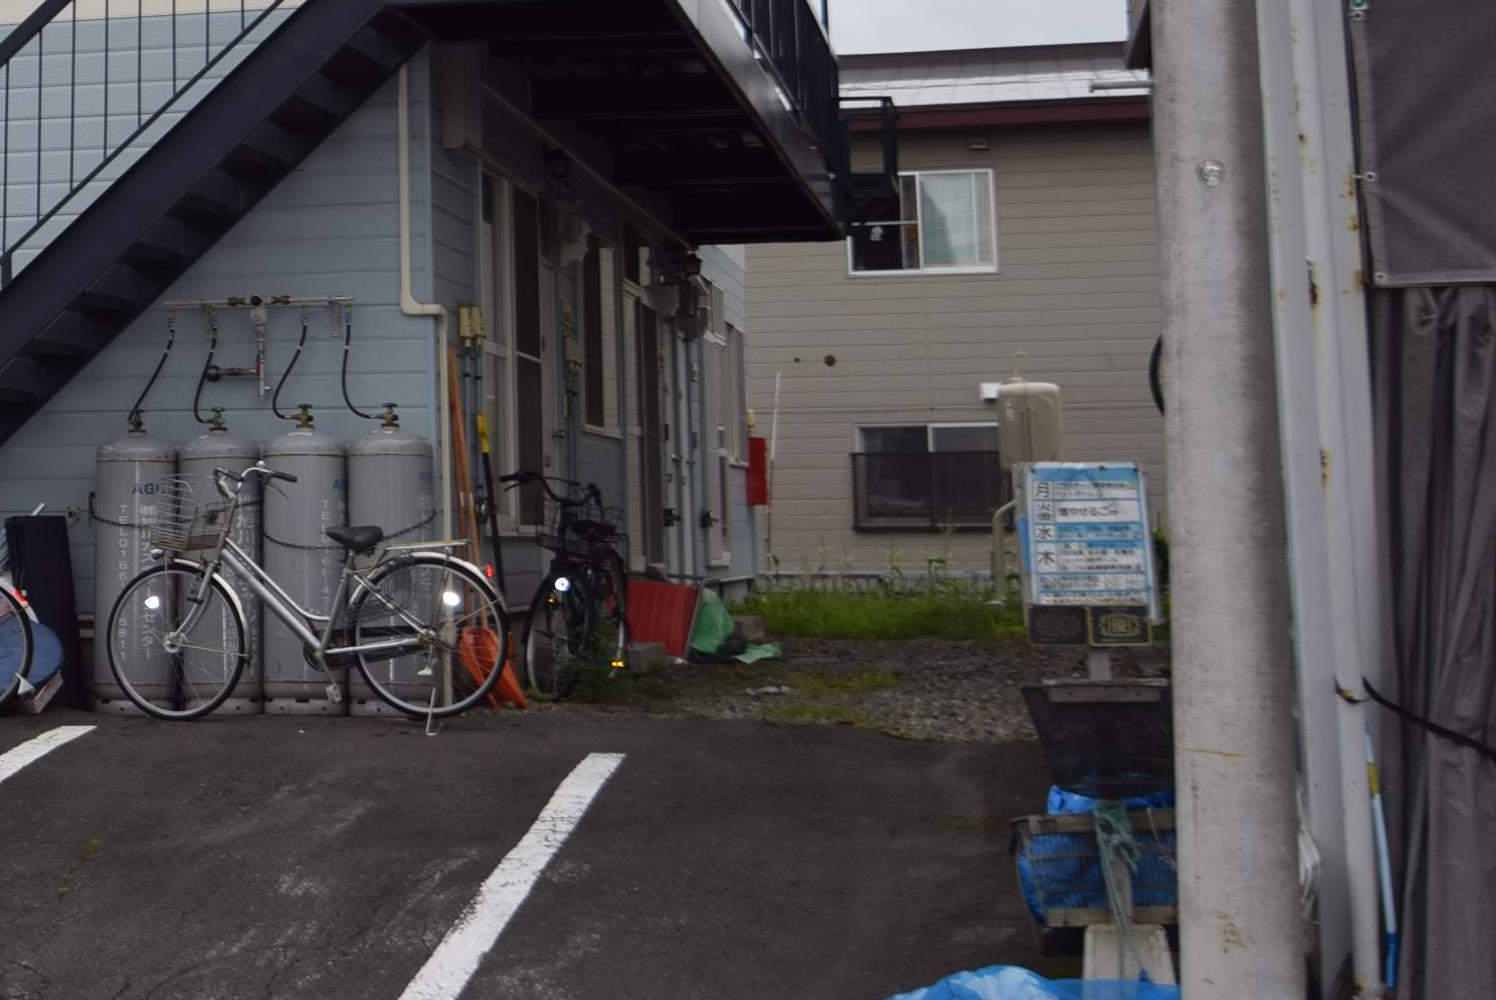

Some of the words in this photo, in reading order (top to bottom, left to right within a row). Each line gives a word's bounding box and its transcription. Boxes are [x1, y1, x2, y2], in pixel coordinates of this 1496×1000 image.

[1037, 482, 1050, 498] 月
[1037, 525, 1053, 541] 水
[1037, 549, 1056, 566] 木
